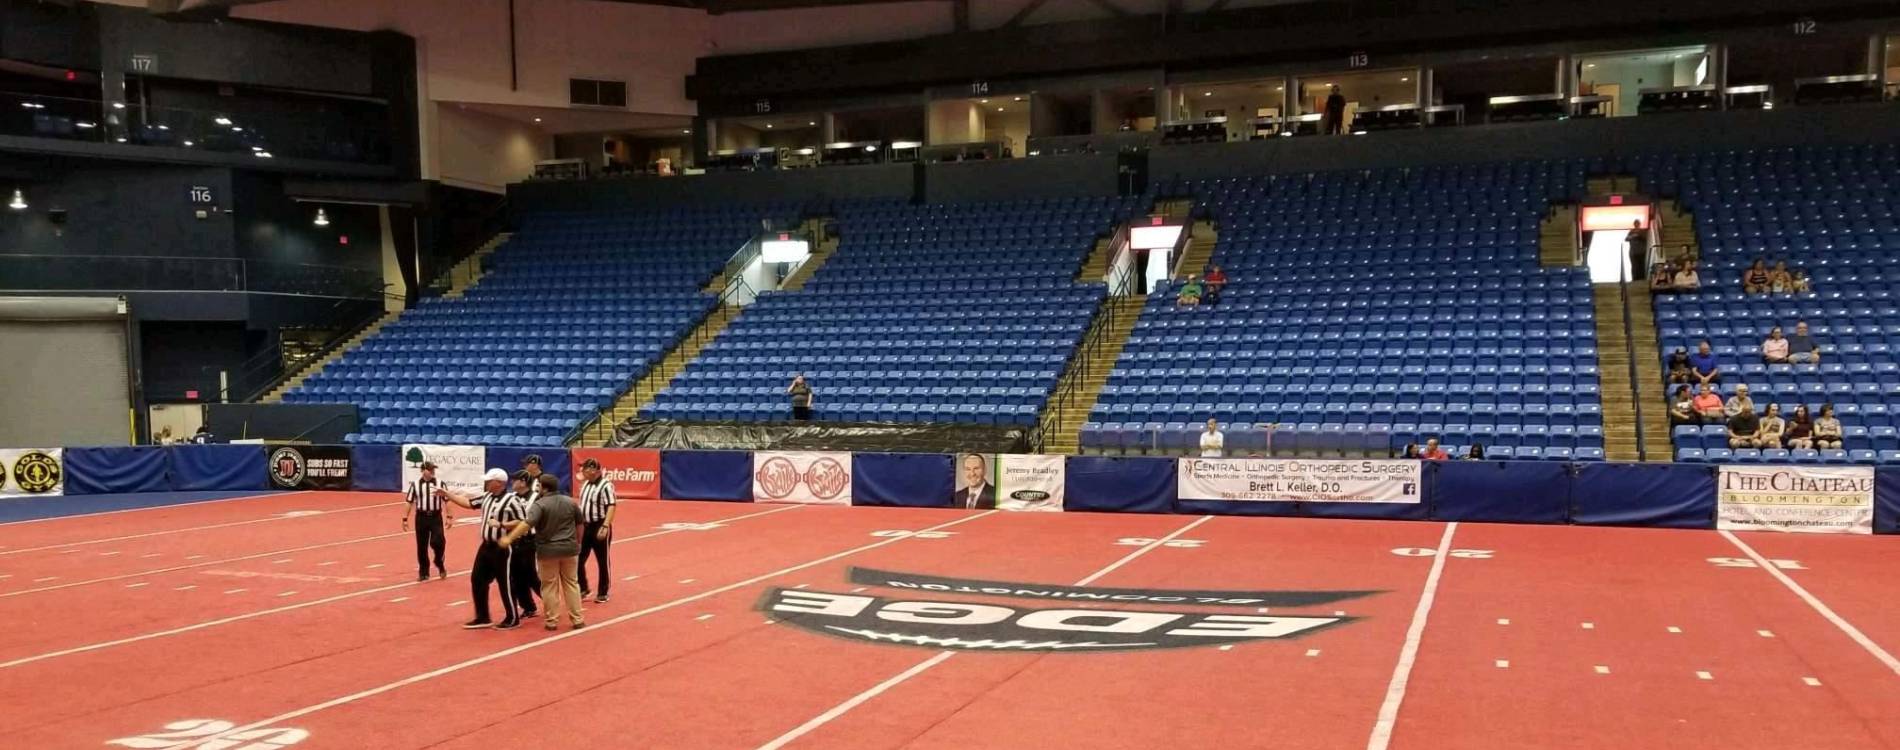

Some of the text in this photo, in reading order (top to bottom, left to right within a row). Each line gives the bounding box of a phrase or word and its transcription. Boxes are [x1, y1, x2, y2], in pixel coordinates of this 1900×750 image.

[1793, 21, 1816, 35] 112
[131, 59, 152, 71] 117
[1348, 54, 1369, 68] 113
[971, 83, 989, 95] 114
[755, 102, 772, 113] 115
[190, 189, 212, 203] 116
[306, 459, 349, 468] SUBS SO FAST
[425, 455, 481, 465] LEGACY CARE
[306, 468, 326, 477] YOU'LL
[1006, 466, 1059, 475] Jeremy Bradley
[1193, 460, 1418, 473] CENTRAL ILLINOIS ORTHOPEDIC SURGERY
[1246, 473, 1279, 481] Orthopedic
[1718, 471, 1873, 492] THE CHATEAU
[1249, 481, 1274, 492] Brett
[1321, 483, 1343, 493] D.O.
[1730, 495, 1862, 504] BLOOMINGTON
[1723, 507, 1748, 515] HOTEL
[1775, 508, 1831, 517] CONFERENCE
[1730, 518, 1854, 528] www.bloomingtonchateau.com
[1389, 547, 1496, 559] 20
[1706, 556, 1811, 570] 15
[886, 579, 1266, 605] BLOOMINGTON
[772, 590, 1345, 637] EDGE
